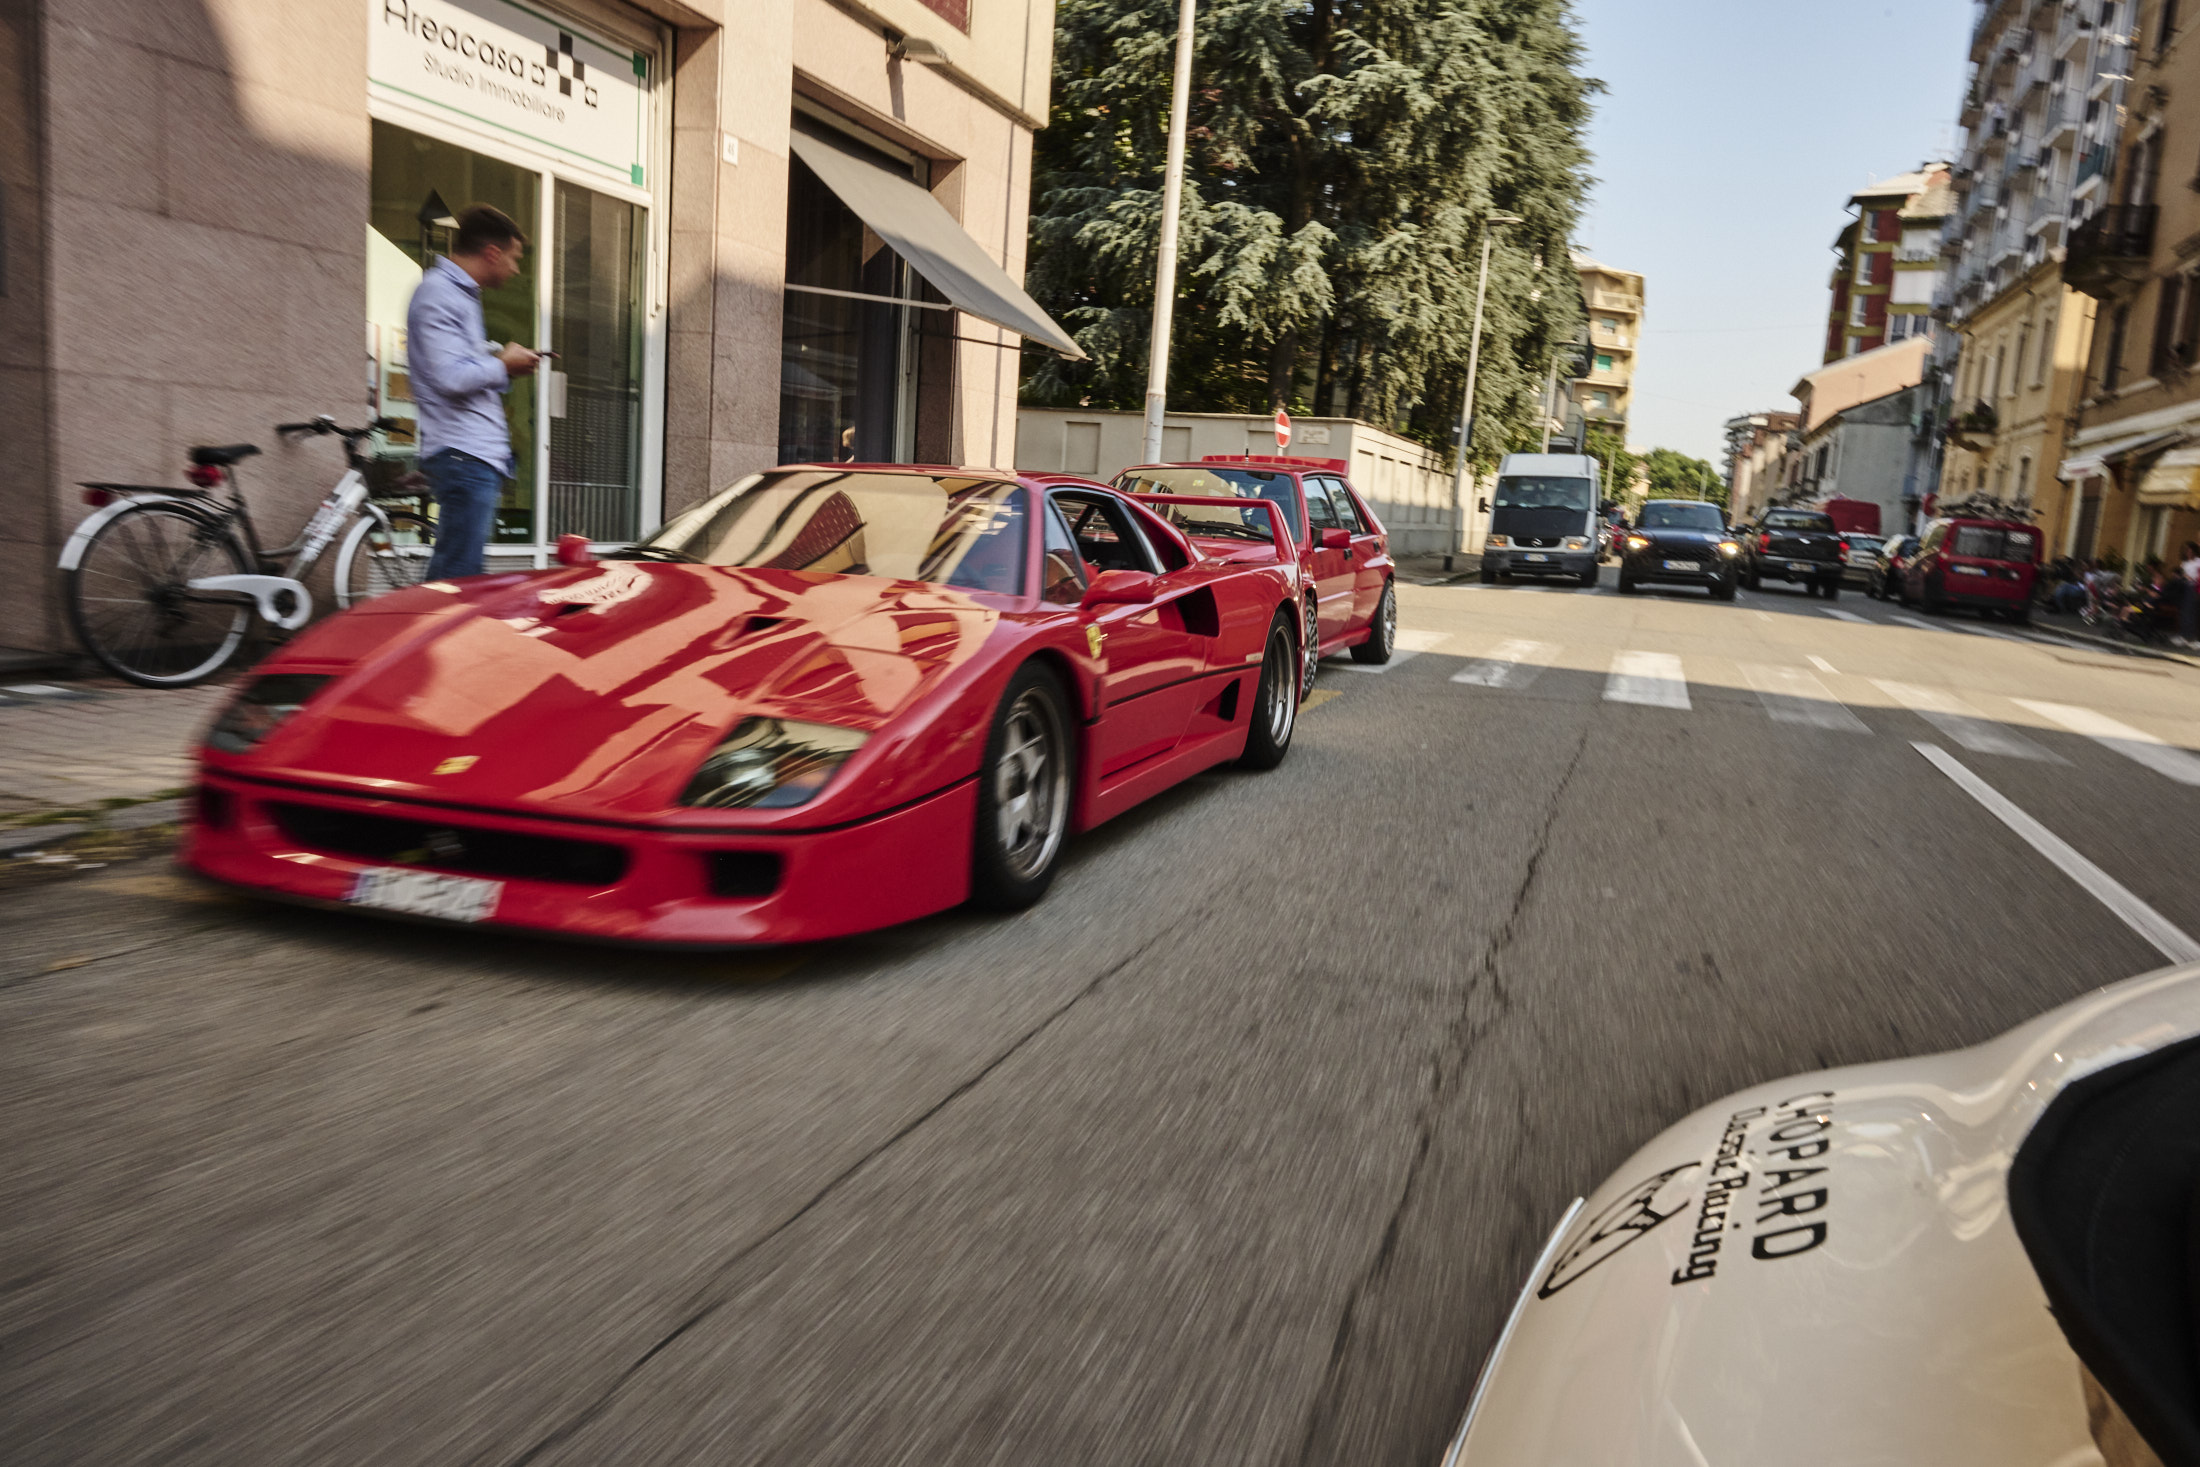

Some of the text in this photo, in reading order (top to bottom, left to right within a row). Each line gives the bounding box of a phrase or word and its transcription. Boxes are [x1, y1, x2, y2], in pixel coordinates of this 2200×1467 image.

[384, 0, 525, 79] Areacasa
[424, 51, 566, 123] Studio Immobiliare
[1752, 1090, 1836, 1260] CHOPARD
[1671, 1171, 1749, 1286] Racing
